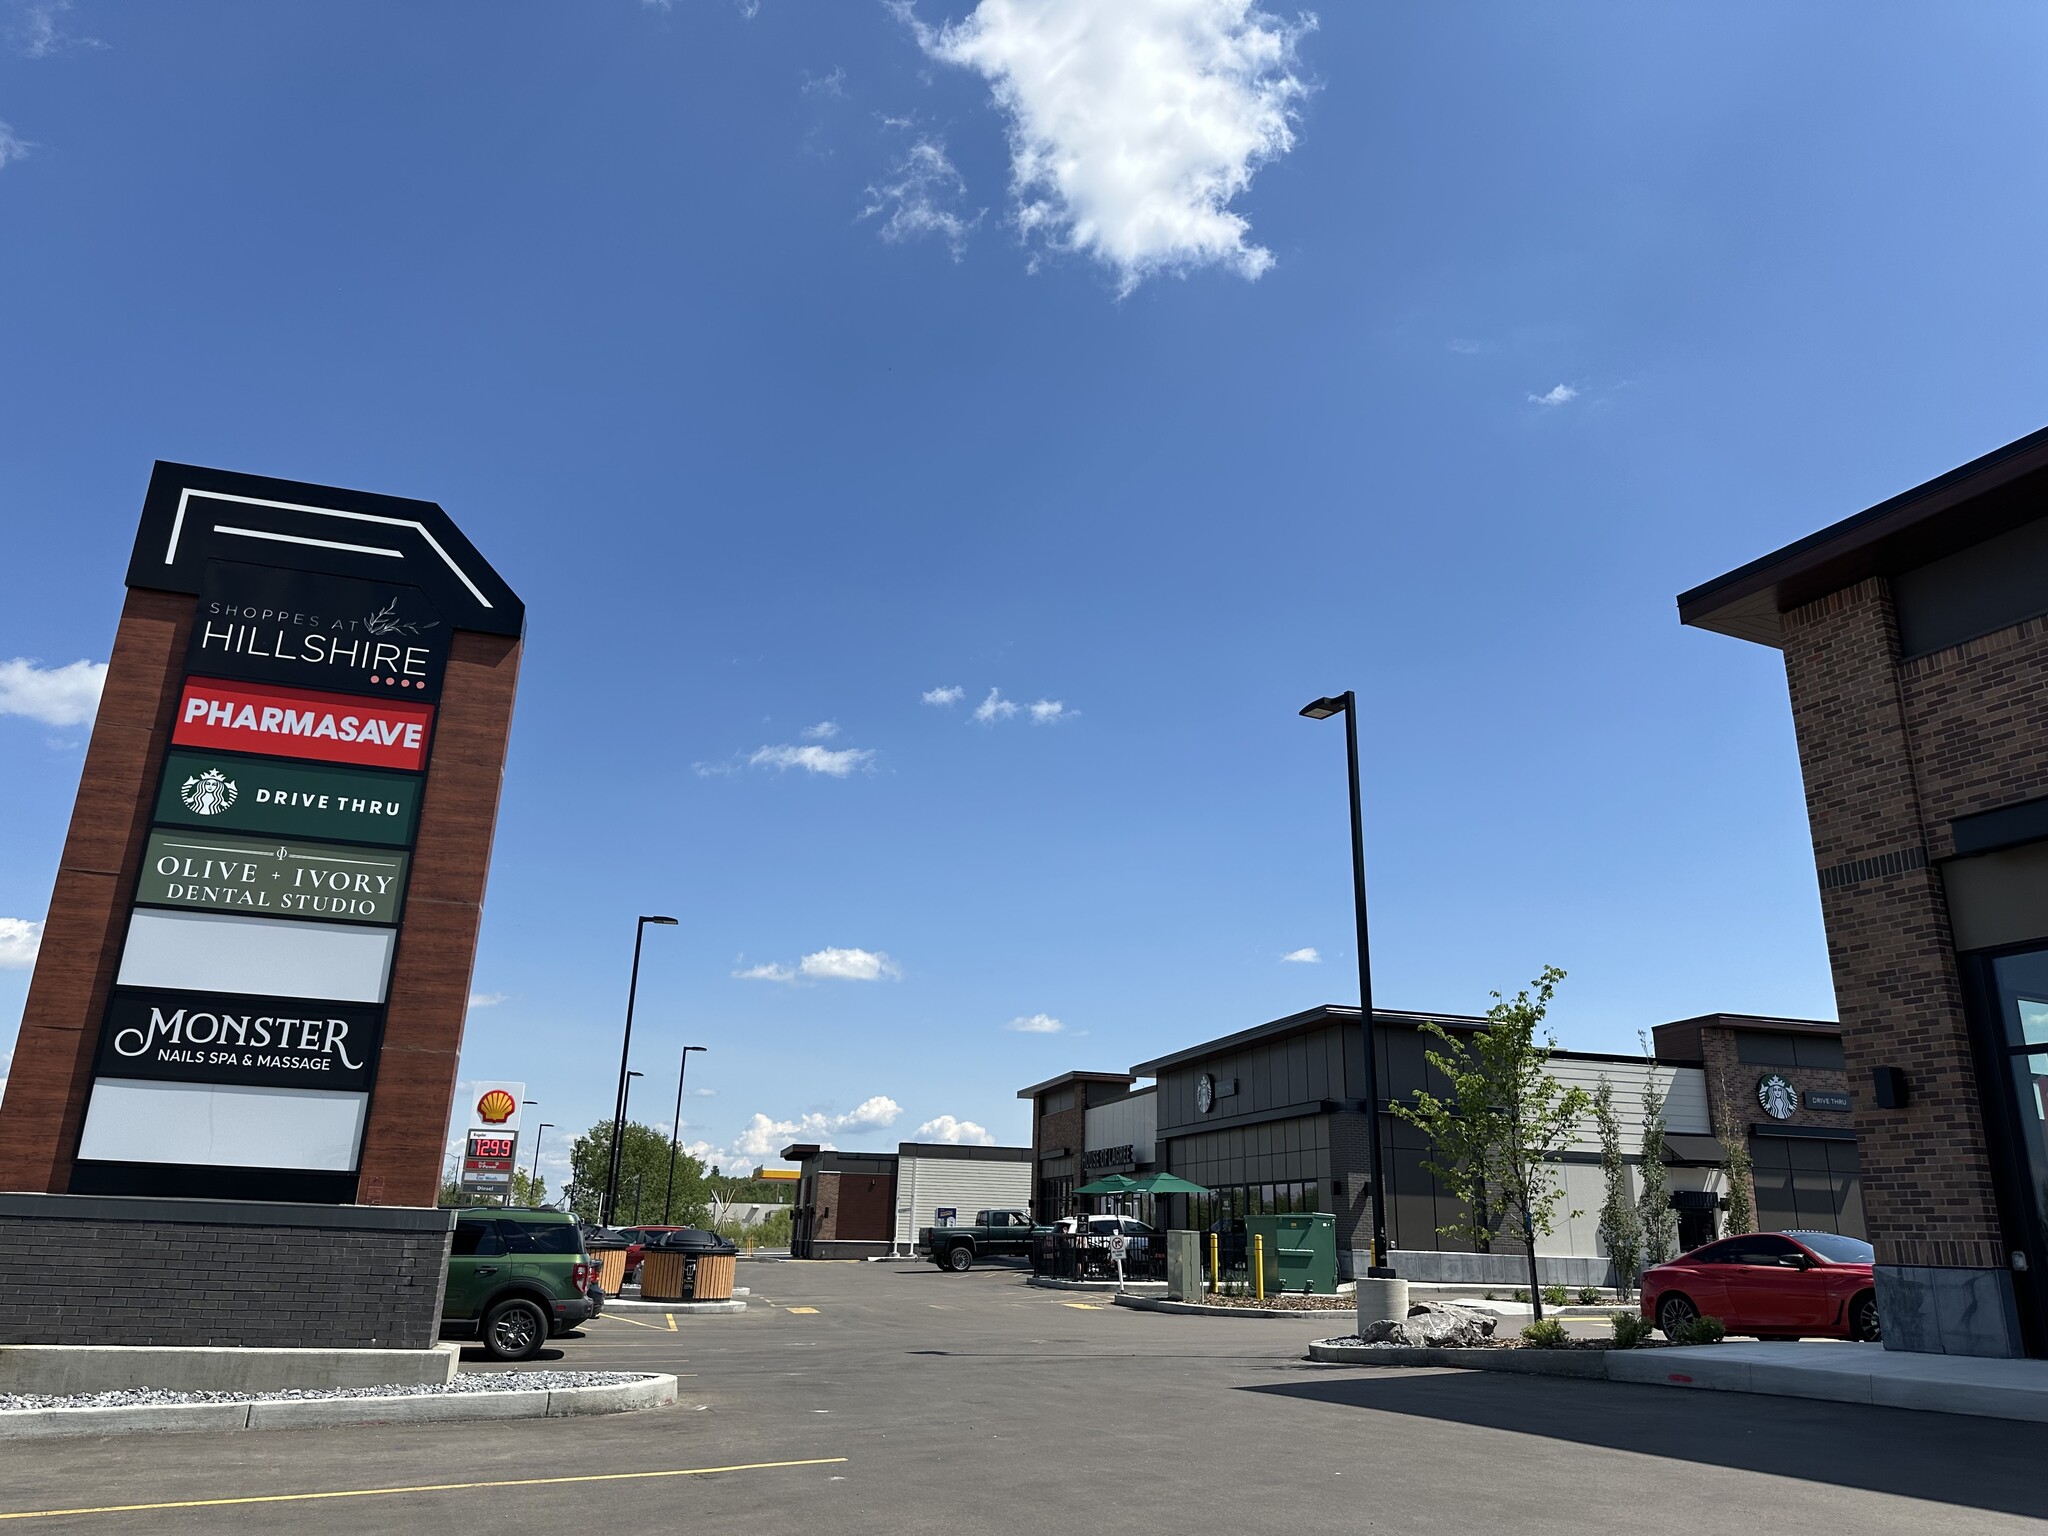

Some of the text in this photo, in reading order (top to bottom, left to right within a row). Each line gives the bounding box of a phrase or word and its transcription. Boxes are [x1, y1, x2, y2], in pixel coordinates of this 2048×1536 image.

[209, 602, 358, 632] SHOPPES AT
[201, 620, 430, 676] HILLSHIRE
[183, 697, 423, 749] PHARMASAVE
[255, 788, 400, 816] DRIVE THRU
[156, 855, 258, 883] OLIVE
[293, 867, 395, 895] IVORY
[166, 882, 376, 916] DENTAL STUDIO
[114, 1007, 364, 1070] MONSTER
[157, 1048, 331, 1071] NAILS SPA & MASSAGE
[1812, 1097, 1847, 1106] DRIVE THRU
[476, 1139, 511, 1157] 129.9
